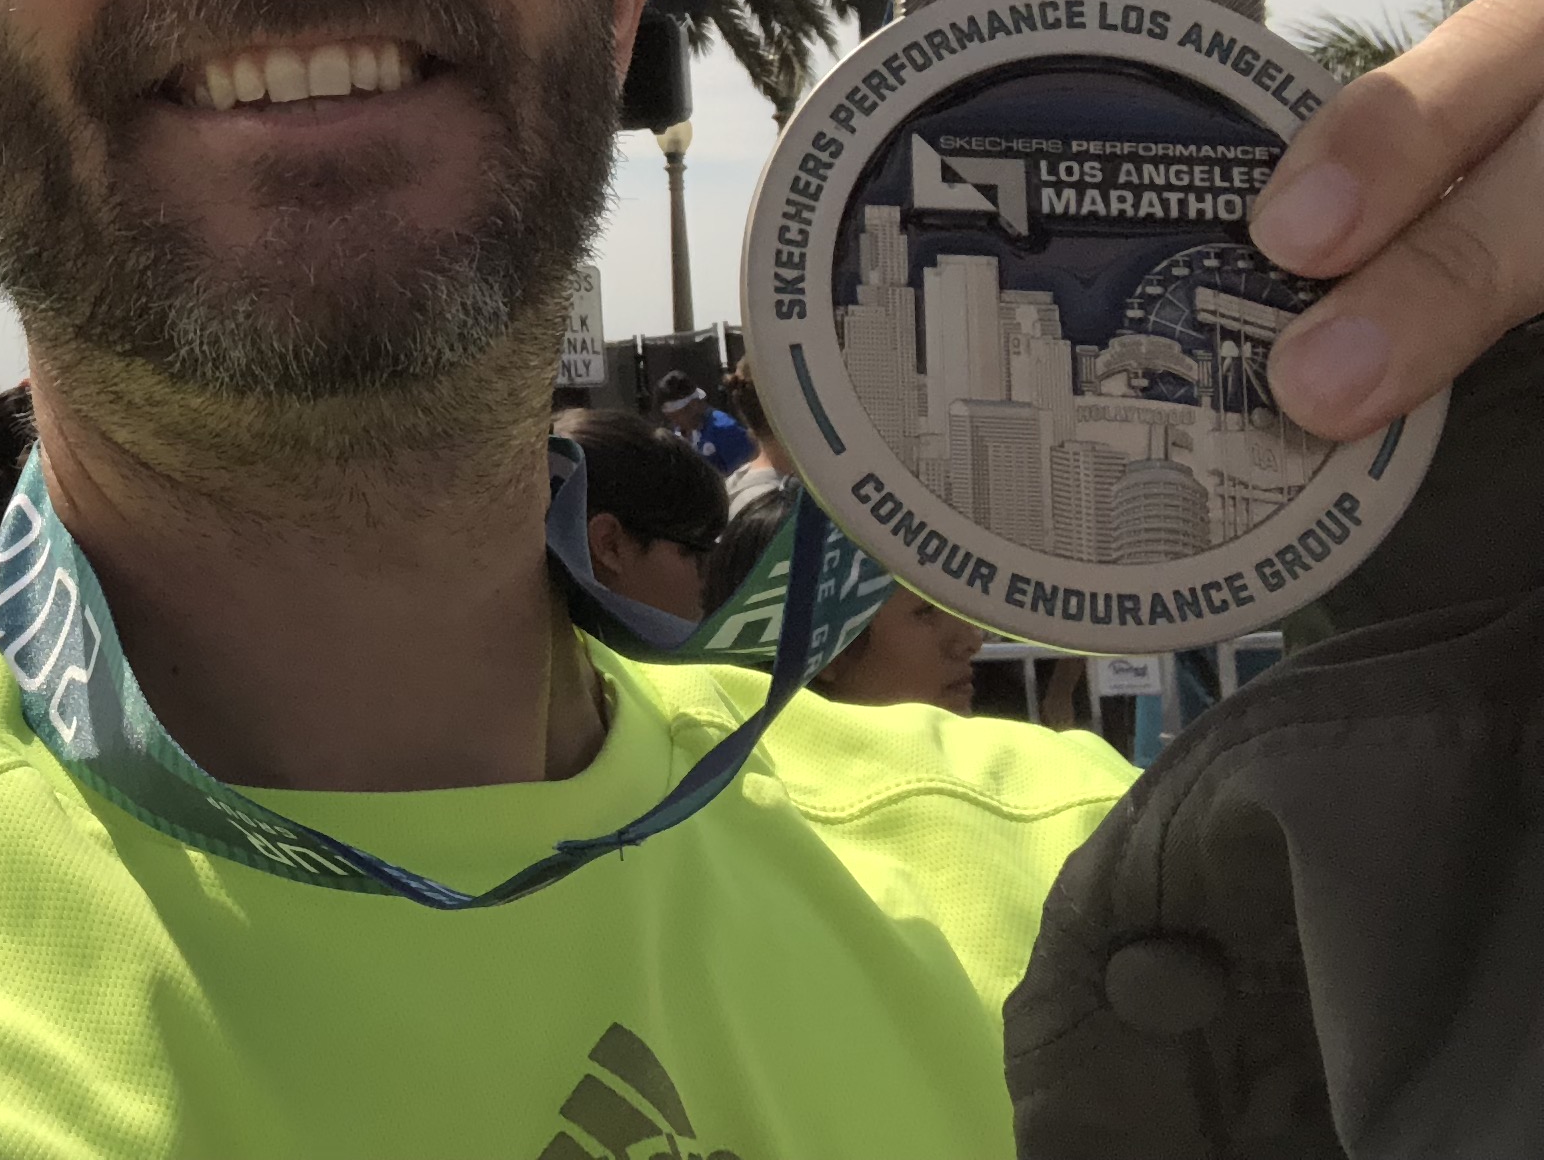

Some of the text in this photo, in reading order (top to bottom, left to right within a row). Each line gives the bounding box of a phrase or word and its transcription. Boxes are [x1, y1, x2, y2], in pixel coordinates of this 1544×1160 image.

[939, 135, 1063, 154] SKECHERS
[774, 0, 1324, 321] SKECHERS PERFORMANCE LOS ANGELE
[1039, 158, 1103, 184] LOS
[1040, 188, 1250, 222] MARATHO
[566, 336, 601, 356] NAL
[561, 358, 592, 378] NLY
[850, 471, 999, 597] CONQUR
[1004, 571, 1256, 627] ENDURANCE
[1254, 490, 1363, 593] GROUP
